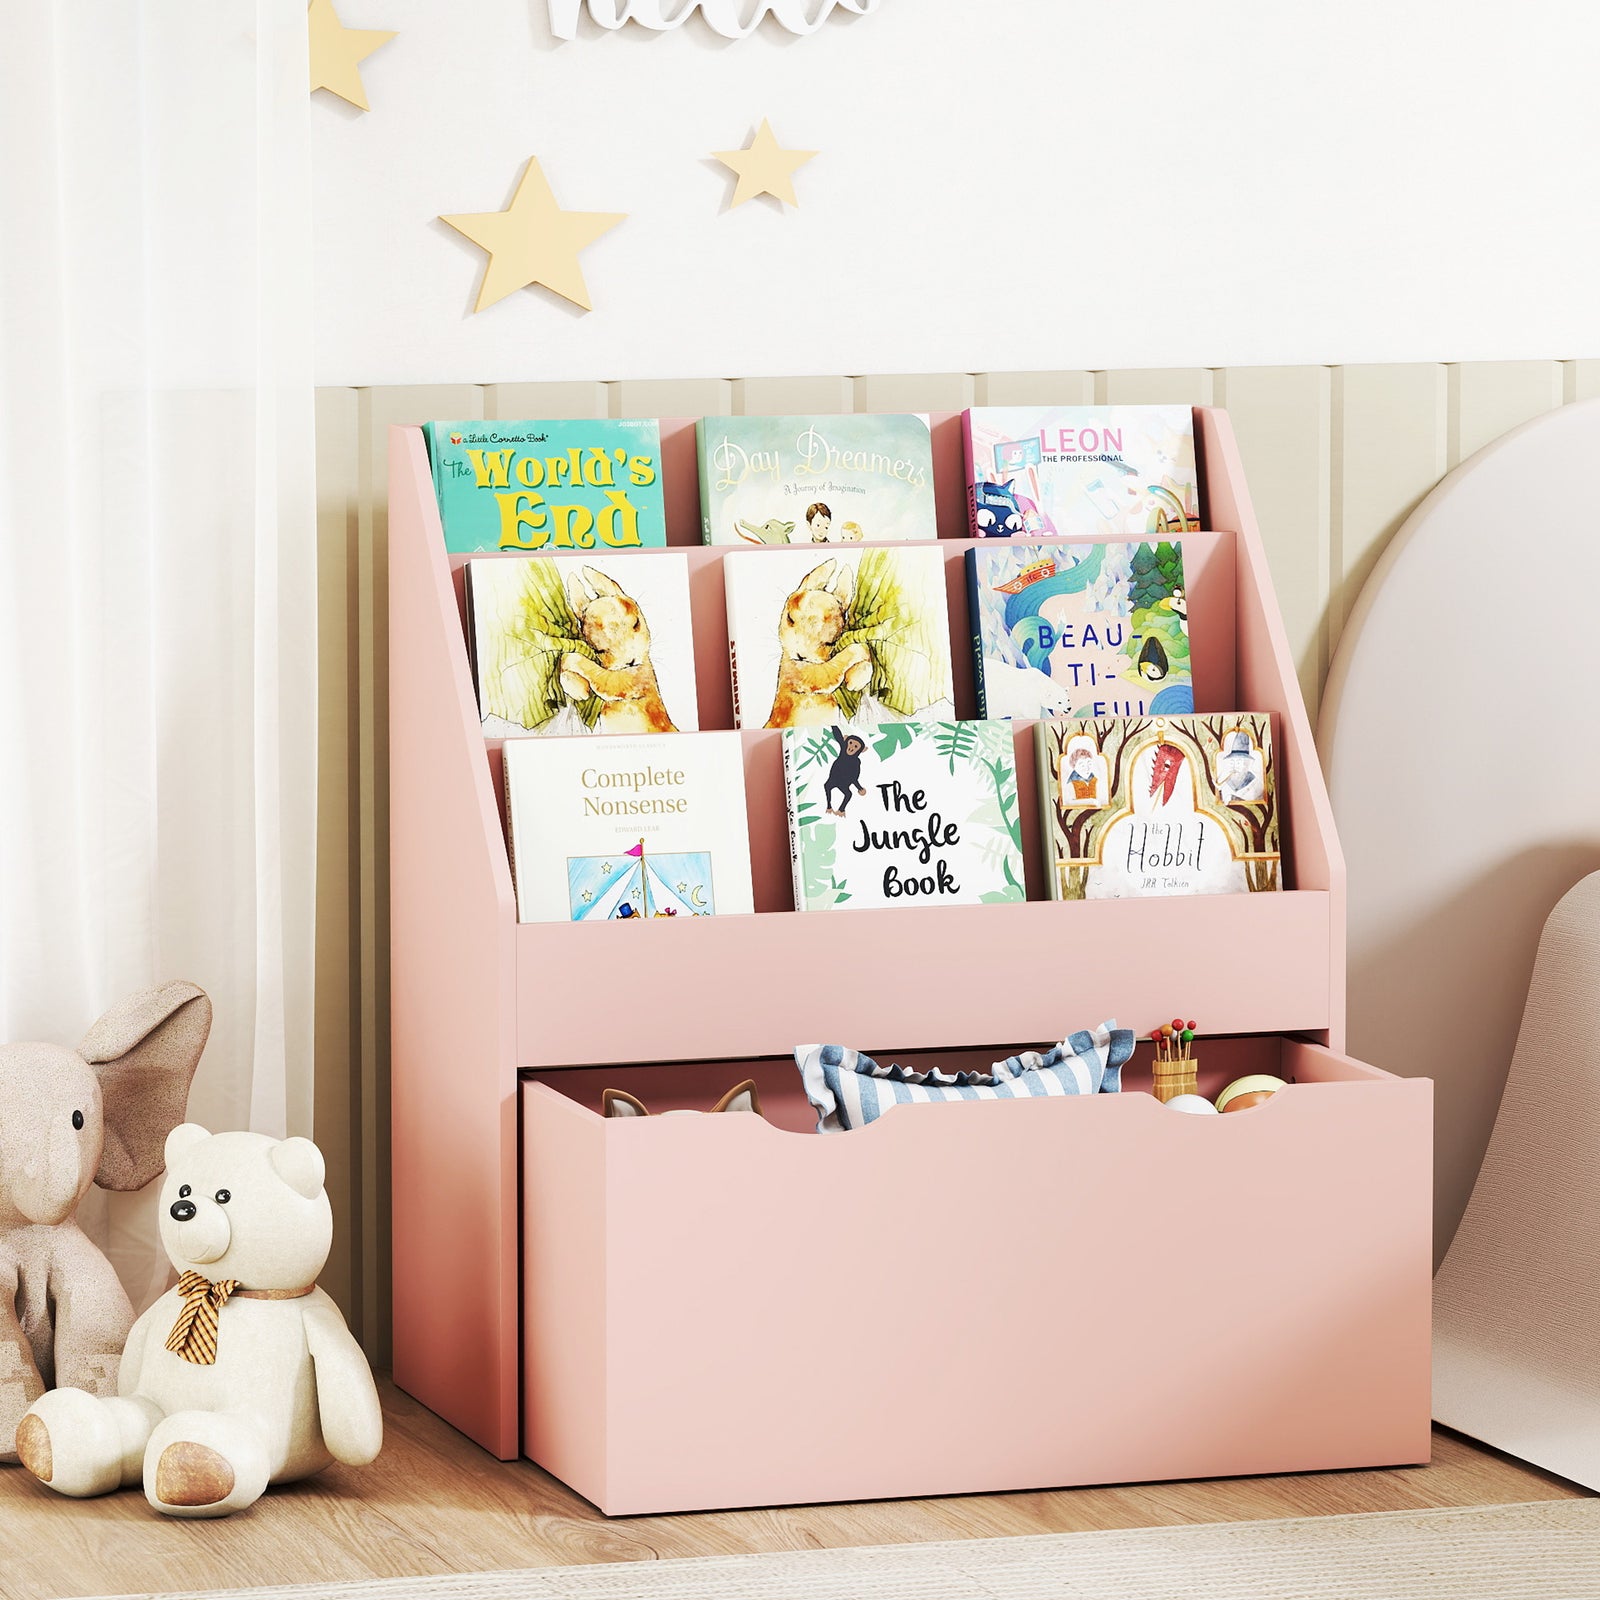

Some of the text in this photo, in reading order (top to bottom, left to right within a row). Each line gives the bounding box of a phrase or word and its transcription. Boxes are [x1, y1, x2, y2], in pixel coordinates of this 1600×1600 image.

[469, 433, 489, 444] Little
[489, 432, 526, 444] Cornetto
[1040, 428, 1123, 452] LEON
[443, 447, 656, 489] The World's
[713, 424, 926, 492] Day Dreamers
[1042, 454, 1124, 463] THE PROFESSIONAL
[493, 489, 643, 550] End
[1038, 623, 1143, 650] BEAU-
[1067, 663, 1116, 687] TI-
[581, 766, 685, 792] Complete
[583, 796, 688, 817] Nonsense
[875, 780, 927, 814] The
[852, 812, 961, 864] Jungle
[1151, 822, 1163, 835] the
[1126, 821, 1205, 874] Hobbit
[883, 859, 961, 898] Book
[1141, 877, 1189, 889] JRR Tolkien
